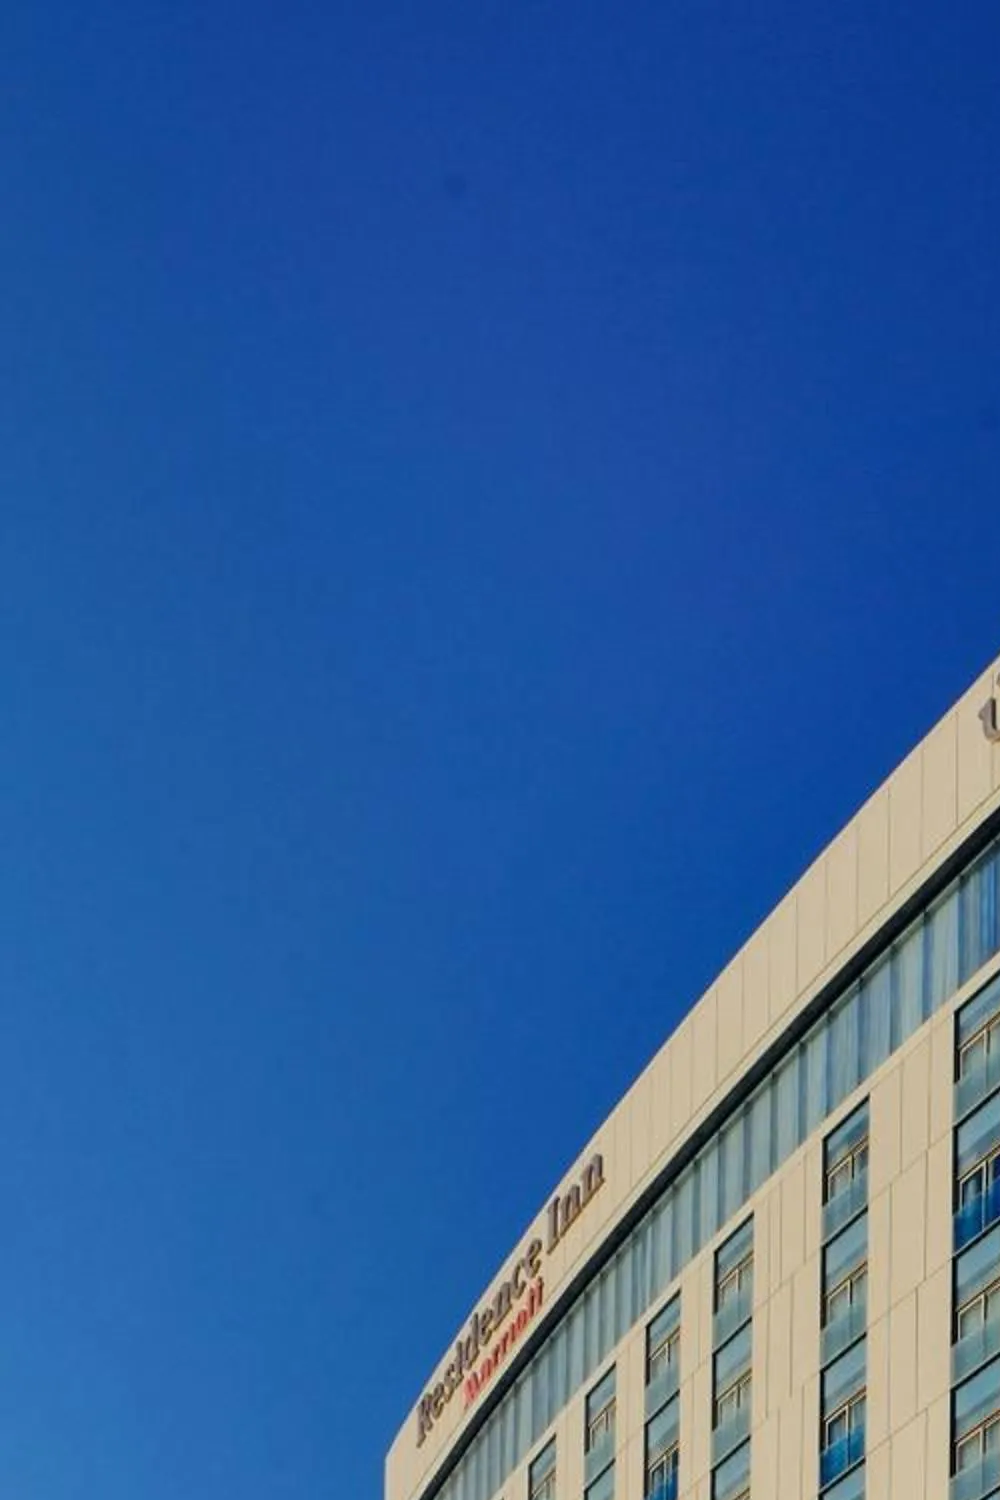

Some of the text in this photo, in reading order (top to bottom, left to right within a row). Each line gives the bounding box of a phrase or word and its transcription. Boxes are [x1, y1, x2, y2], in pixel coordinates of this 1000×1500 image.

[416, 1153, 606, 1449] Residence Inn
[463, 1275, 544, 1411] Marriott
